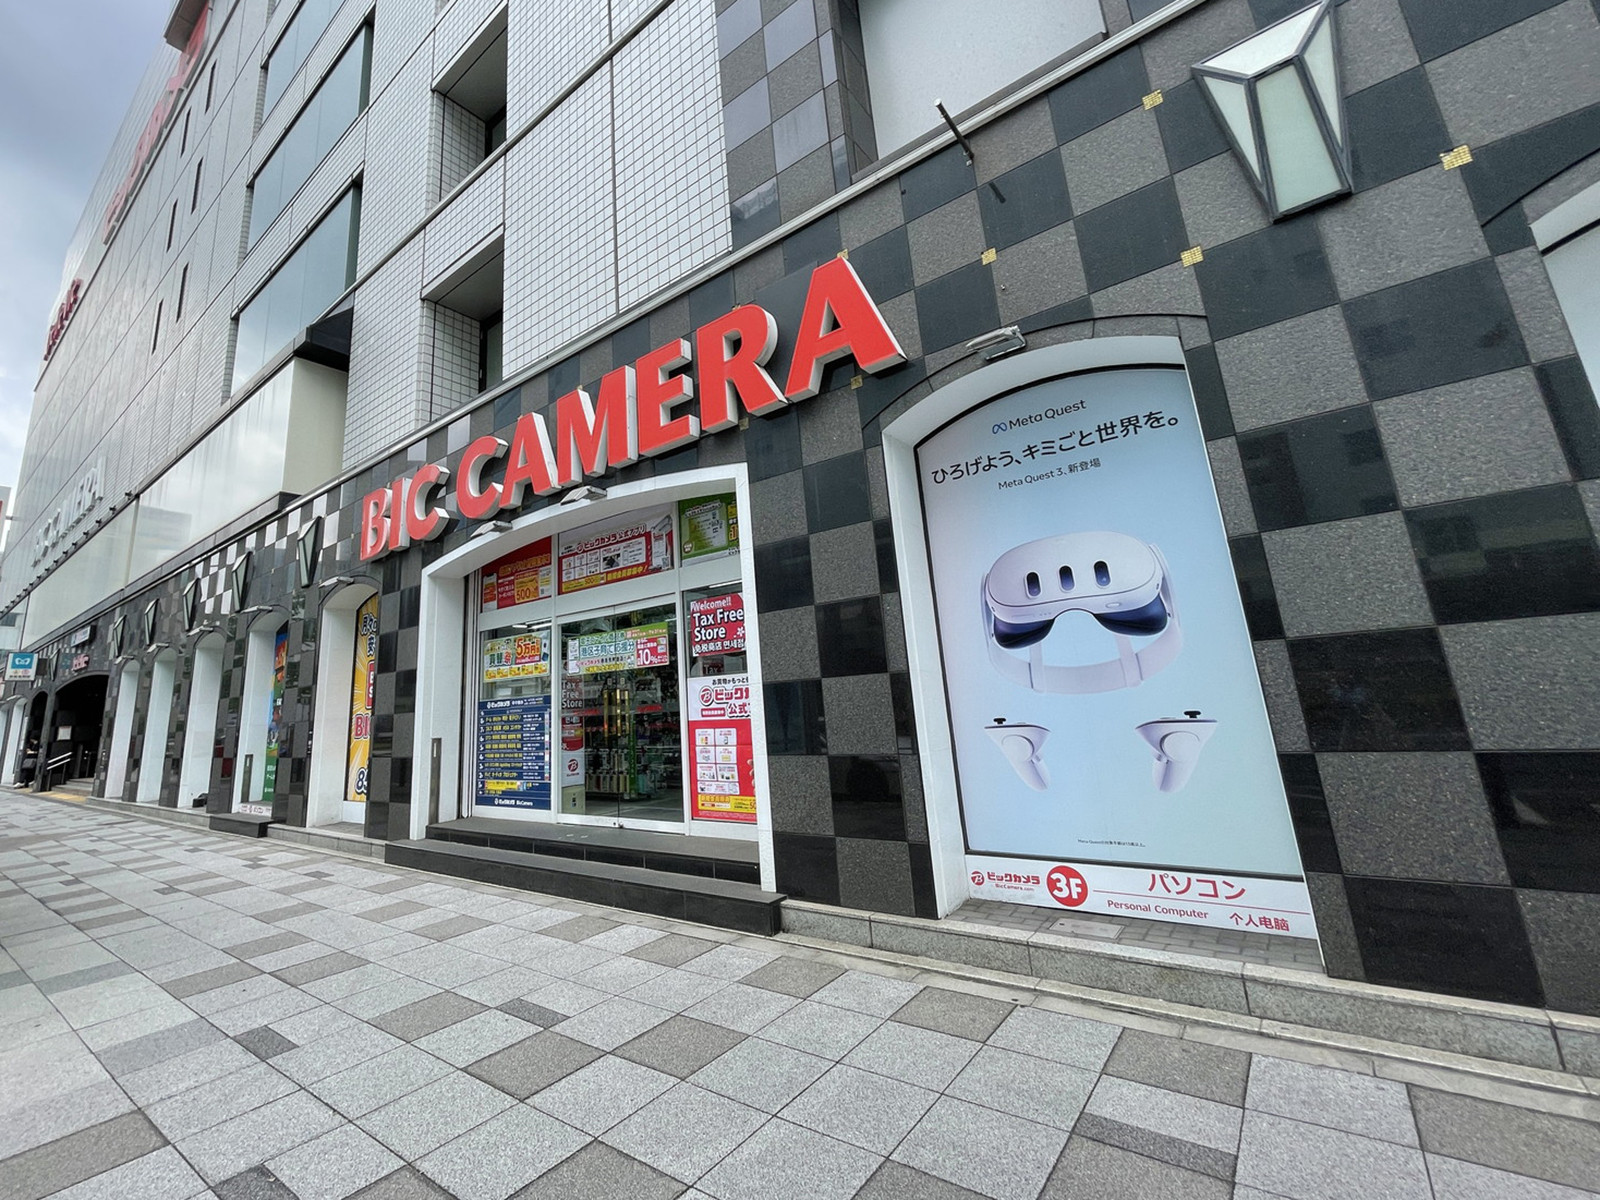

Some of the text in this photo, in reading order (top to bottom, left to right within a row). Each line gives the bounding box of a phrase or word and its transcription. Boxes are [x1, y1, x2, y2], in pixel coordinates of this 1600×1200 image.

[360, 257, 907, 561] BIC CAMERA
[1009, 400, 1087, 430] Meta Quest
[932, 411, 1179, 484] ひろげよう、キミごと世界を。
[998, 478, 1024, 490] Meta
[1025, 470, 1055, 484] Quest
[693, 608, 745, 627] Tax Free
[694, 626, 727, 643] Store
[562, 680, 576, 690] Tax
[562, 690, 579, 699] Free
[561, 699, 583, 709] Store
[987, 871, 1041, 885] ビックカメラ
[1050, 872, 1083, 899] 3F
[1148, 872, 1246, 900] パソコン
[1107, 899, 1209, 919] Personal Computer
[1230, 912, 1290, 932] 个人电脑
